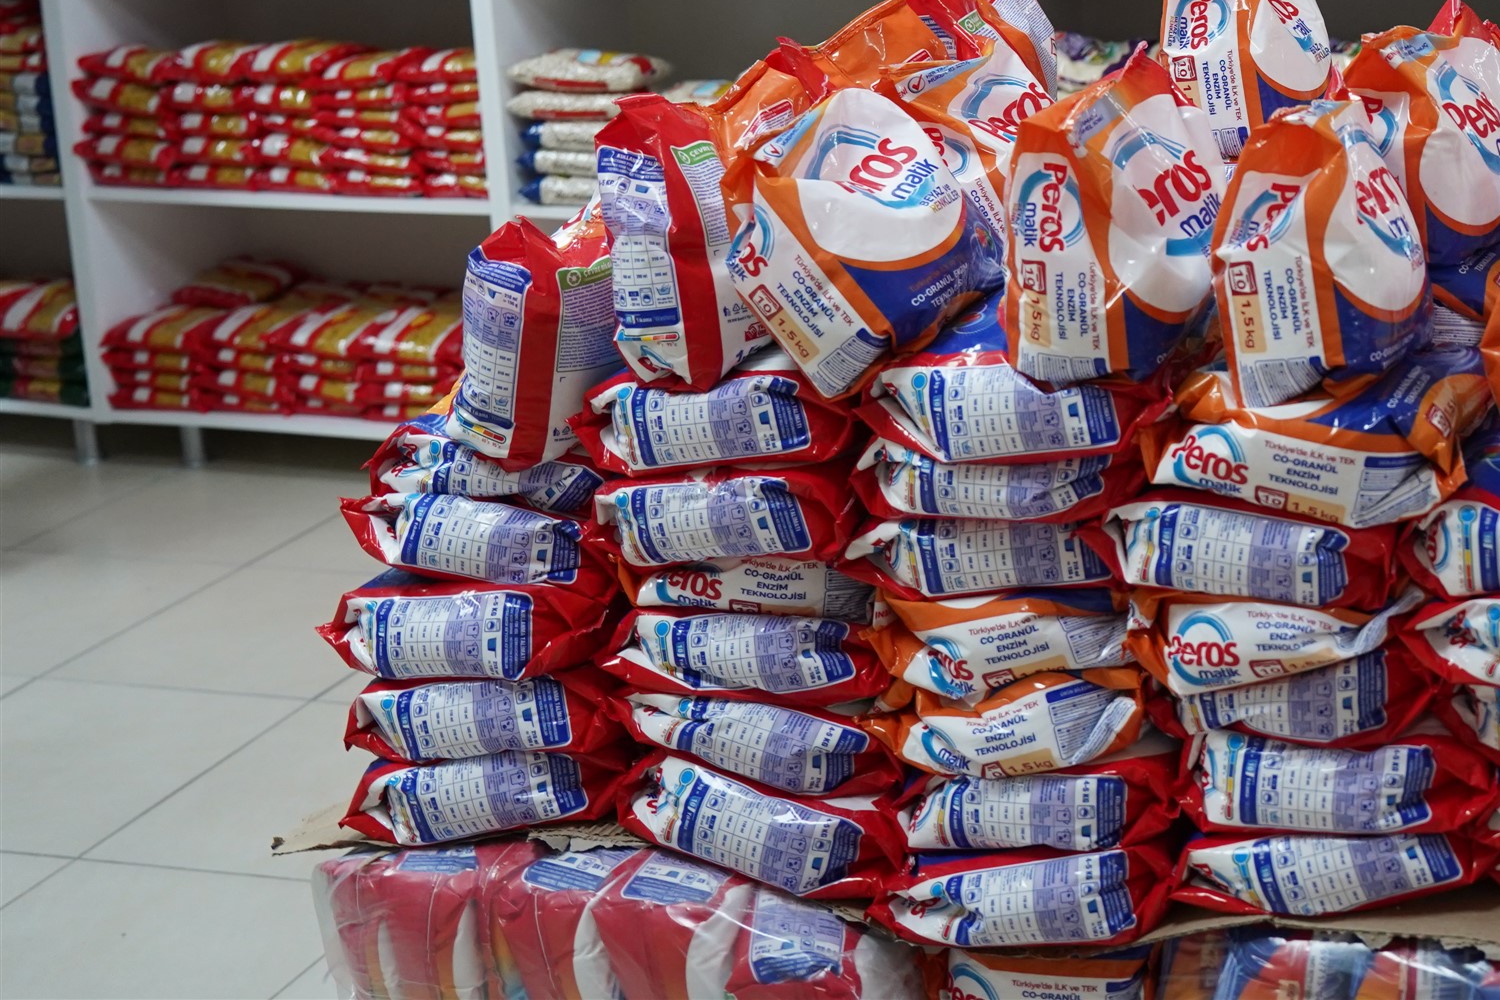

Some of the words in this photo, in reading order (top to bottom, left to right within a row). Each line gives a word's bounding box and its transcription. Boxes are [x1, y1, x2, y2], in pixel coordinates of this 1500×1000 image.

[1179, 62, 1187, 77] 10
[1227, 49, 1236, 84] Türkiye'de
[1202, 61, 1216, 115] TEKNOLOJİSİ
[1212, 73, 1221, 99] ENZİM
[1220, 59, 1232, 110] CO-GRANÜL
[1231, 86, 1239, 96] İLK
[1233, 98, 1238, 106] ve
[892, 158, 939, 200] matik
[1039, 162, 1067, 253] Peros
[1179, 192, 1222, 238] matik
[1024, 202, 1037, 247] matik
[1234, 269, 1245, 290] 10
[790, 268, 838, 323] CO-GRANÜL
[791, 254, 825, 292] Türkiye'de
[821, 288, 836, 303] İLK
[830, 301, 841, 312] ve
[839, 310, 854, 327] TEK
[754, 294, 773, 314] 10
[774, 281, 825, 339] TEKNOLOJİSİ
[792, 287, 819, 318] ENZİM
[1055, 272, 1066, 340] TEKNOLOJİSİ
[1067, 289, 1076, 322] ENZİM
[1078, 272, 1088, 337] CO-GRANÜL
[1263, 270, 1282, 340] TEKNOLOJİSİ
[1276, 285, 1289, 319] ENZİM
[1285, 268, 1302, 335] CO-GRANÜL
[1301, 302, 1310, 316] İLK
[1240, 300, 1253, 326] 1,5
[774, 316, 798, 342] 1,5
[792, 339, 811, 359] kg
[1030, 323, 1043, 341] kg
[1244, 330, 1256, 349] kg
[1305, 331, 1315, 348] TEK
[1092, 335, 1100, 351] TEK
[1171, 434, 1249, 486] Peros
[1272, 452, 1339, 474] CO-GRANÜL
[1309, 450, 1326, 461] İLK
[1340, 455, 1357, 466] TEK
[1267, 473, 1340, 496] TEKNOLOJİSİ
[1286, 467, 1321, 482] ENZİM
[744, 568, 804, 581] CO-GRANÜL
[741, 588, 807, 600] TEKNOLOJİSİ
[756, 581, 789, 591] ENZİM
[677, 594, 717, 608] matik
[490, 607, 498, 617] KG
[1318, 618, 1334, 631] TEK
[980, 626, 1040, 645] CO-GRANÜL
[996, 639, 1028, 652] ENZİM
[984, 642, 1050, 665] TEKNOLOJİSİ
[1168, 635, 1240, 668] Peros
[1198, 668, 1241, 680] matik
[1024, 700, 1039, 711] TEK
[974, 735, 1037, 756] TEKNOLOJİSİ
[985, 729, 1016, 743] ENZİM
[938, 747, 971, 771] matik
[1036, 760, 1054, 771] kg
[1012, 979, 1052, 991] Türkiye'de
[1054, 982, 1068, 991] İLK
[1081, 984, 1098, 992] TEK
[1022, 990, 1082, 1000] CO-GRANÜL
